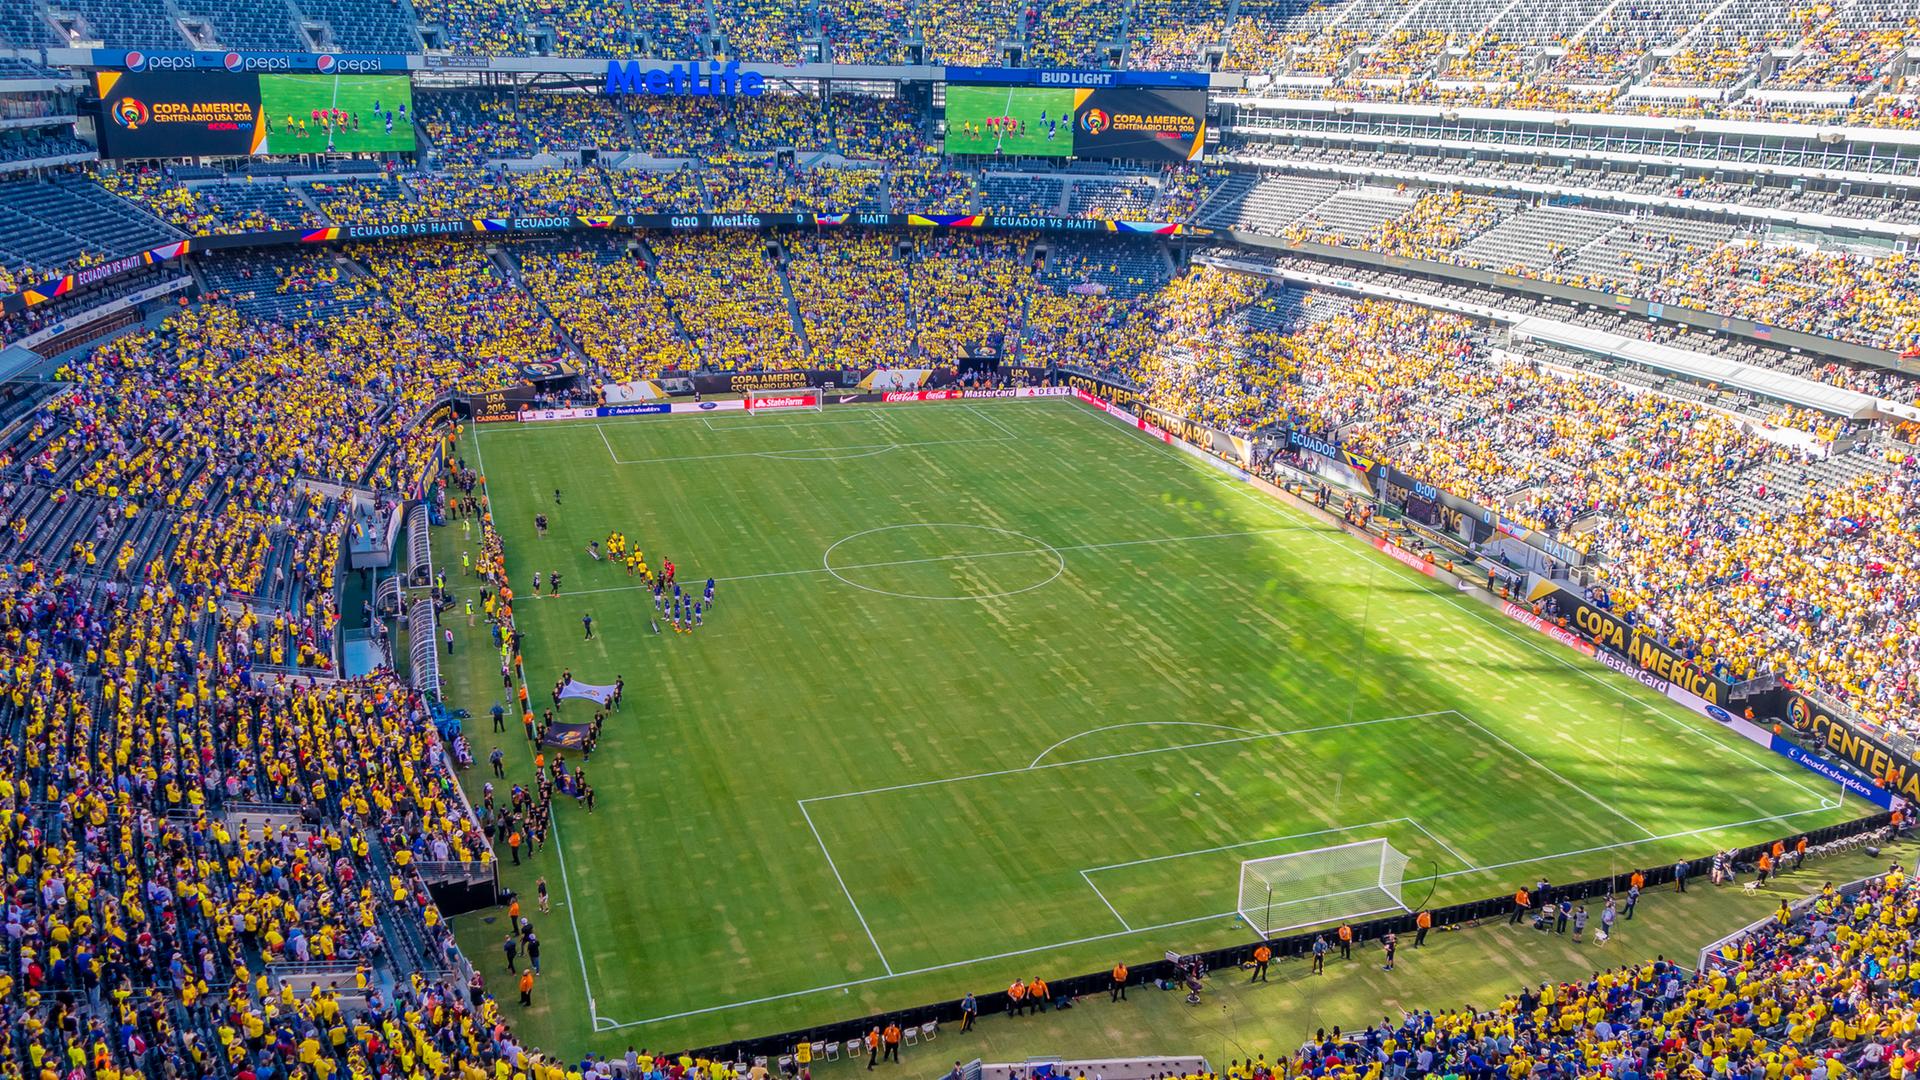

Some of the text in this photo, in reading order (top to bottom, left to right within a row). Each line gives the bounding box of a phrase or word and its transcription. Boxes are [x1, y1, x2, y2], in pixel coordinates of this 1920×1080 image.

[148, 54, 196, 70] pepsi
[245, 55, 291, 71] pepsi
[336, 57, 382, 74] pepsi
[605, 60, 765, 97] MetLife
[1041, 72, 1112, 85] BUD LIGHT
[152, 103, 252, 114] COPA AMERICA
[153, 113, 253, 122] CENTENARIO USA 2016
[1113, 114, 1195, 125] COPA AMERICA
[1113, 123, 1162, 131] CENTENARIO
[1162, 124, 1178, 132] USA
[514, 217, 570, 228] ECUADOR
[626, 214, 635, 225] 0
[671, 216, 699, 227] 0:00
[711, 214, 760, 227] MetLife
[796, 214, 804, 224] 0
[860, 214, 889, 224] HAITI
[993, 216, 1097, 229] ECUADOR VS HAITI
[350, 221, 464, 238] ECUADOR VS HAITI
[77, 255, 141, 286] ECUADOR VS HAITI
[730, 373, 807, 384] COPA AMERICA
[1011, 369, 1030, 378] USA
[964, 389, 1016, 398] MasterCard
[1038, 387, 1071, 395] DELTA
[485, 393, 506, 404] USA
[486, 403, 507, 415] 2016
[1143, 408, 1214, 448] CENTENARIO
[1291, 431, 1337, 459] ECUADOR
[1379, 466, 1387, 478] 0
[1415, 481, 1437, 500] 0:00
[1483, 511, 1491, 524] 0
[1544, 538, 1576, 566] HAITI
[1576, 605, 1718, 705] COPA AMERICA
[1596, 650, 1669, 693] MasterCard
[1812, 714, 1920, 804] CENTENA
